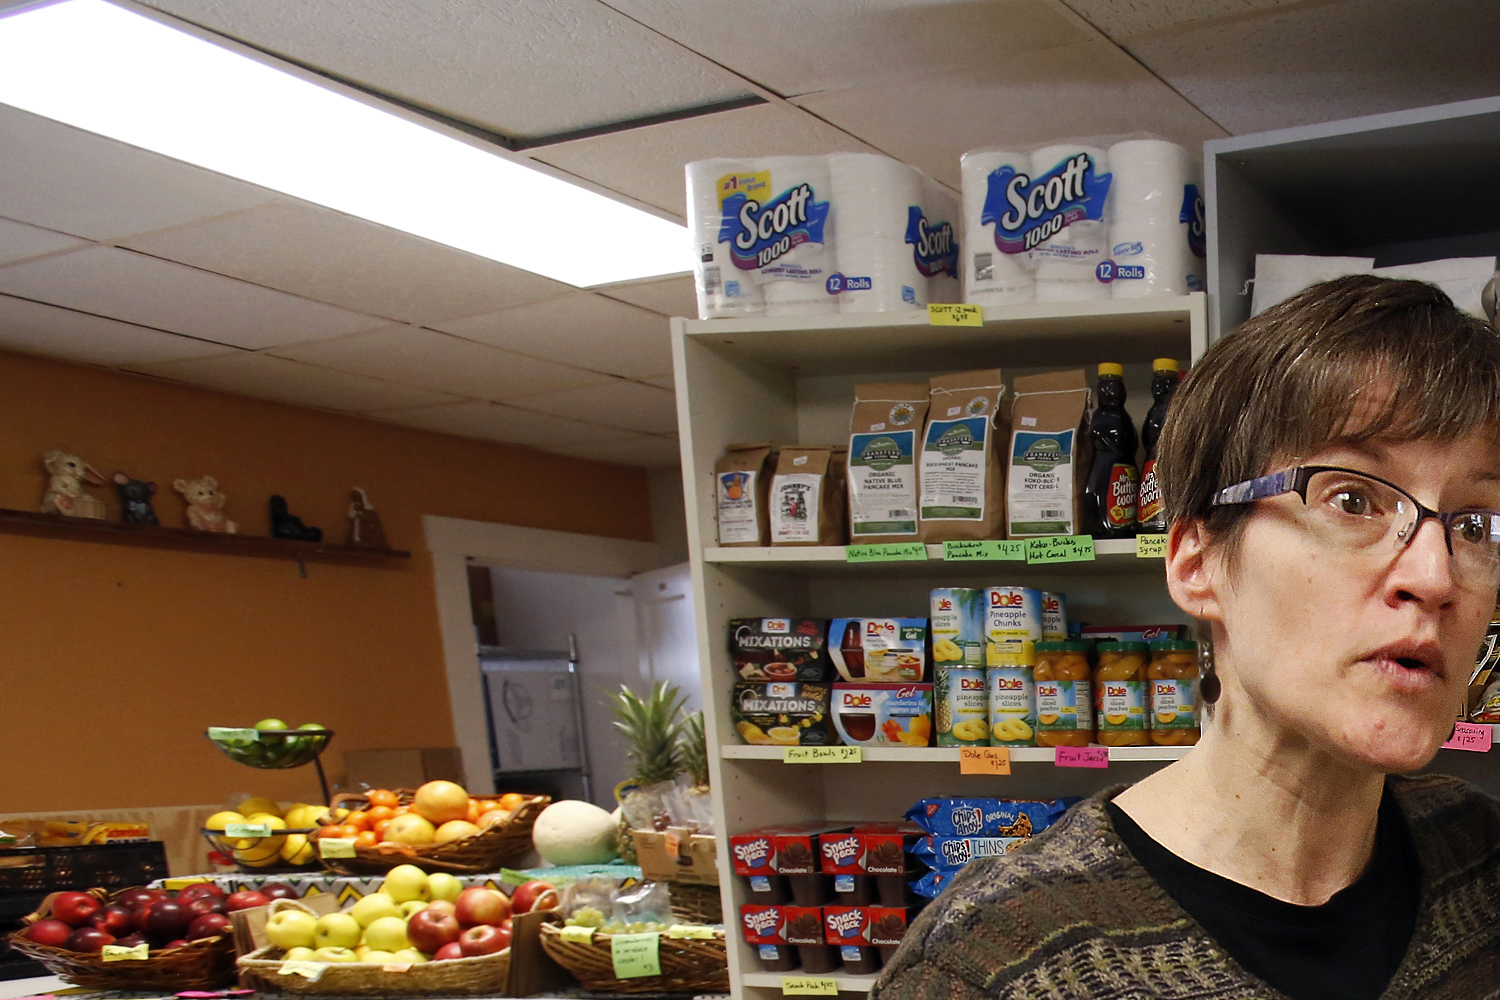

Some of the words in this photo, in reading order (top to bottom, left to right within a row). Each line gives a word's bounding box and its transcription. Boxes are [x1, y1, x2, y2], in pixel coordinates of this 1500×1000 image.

[1001, 153, 1090, 231] Scott
[735, 183, 812, 249] Scott
[1024, 213, 1064, 248] 1000
[757, 236, 791, 266] 1000
[1099, 264, 1112, 278] 12
[1117, 268, 1143, 278] Rolls
[829, 278, 841, 289] 12
[846, 279, 871, 289] Rolls
[989, 611, 1027, 620] Pineapple
[993, 619, 1022, 627] Chunks
[738, 637, 811, 647] MIXATIONS
[998, 679, 1024, 690] Dole
[742, 701, 816, 711] MIXATIONS
[843, 693, 872, 706] Dole
[941, 840, 967, 854] Chips
[971, 840, 1005, 855] THINS
